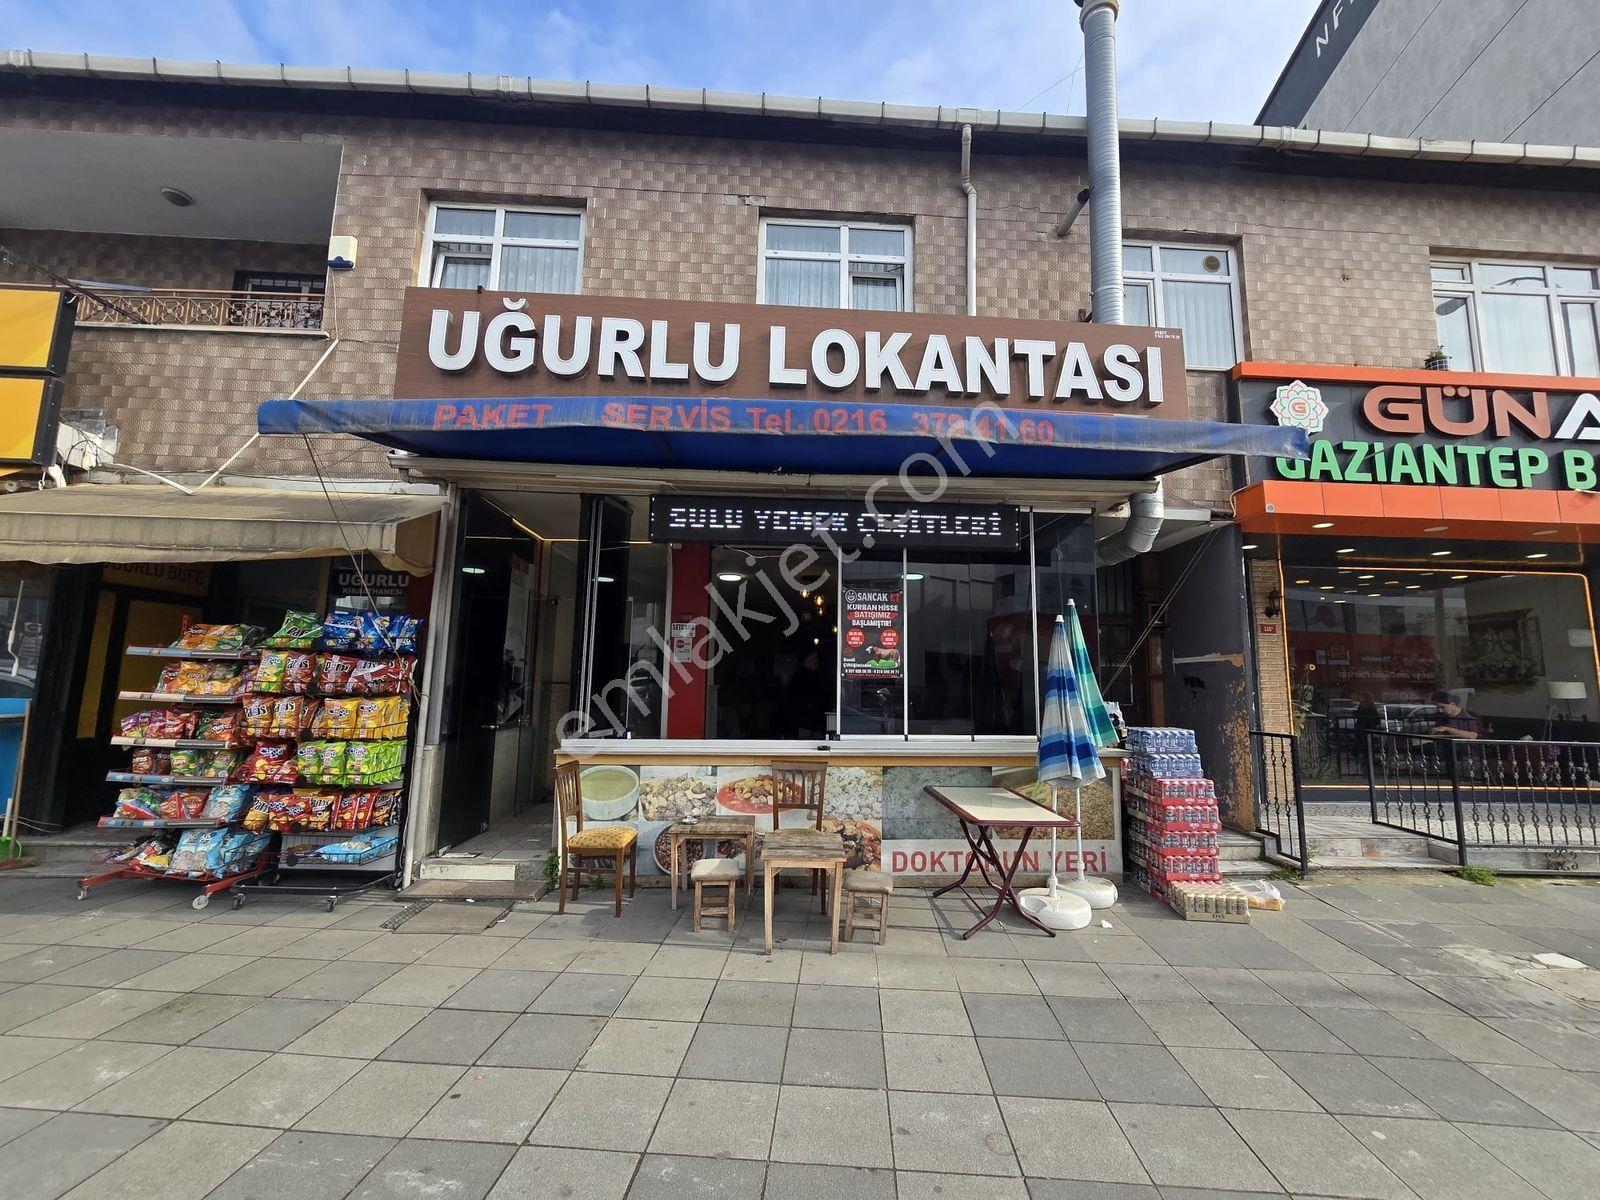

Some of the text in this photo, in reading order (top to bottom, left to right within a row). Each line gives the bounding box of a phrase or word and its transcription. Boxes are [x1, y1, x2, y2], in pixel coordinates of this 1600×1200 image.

[1316, 0, 1354, 59] NF
[428, 297, 1164, 404] UĞURLU LOKANTASI
[433, 404, 553, 430] PAKET
[601, 400, 732, 432] SERVİS
[812, 407, 888, 433] 0216
[1019, 418, 1055, 442] 60
[669, 507, 743, 528] SULU
[754, 509, 849, 532] YEMEK
[847, 603, 899, 612] KURBAN HİSSE
[857, 592, 888, 602] SANCAK
[854, 611, 892, 620] SATIŞIMIZ
[892, 845, 1108, 874] DOKTORUN YERİ
